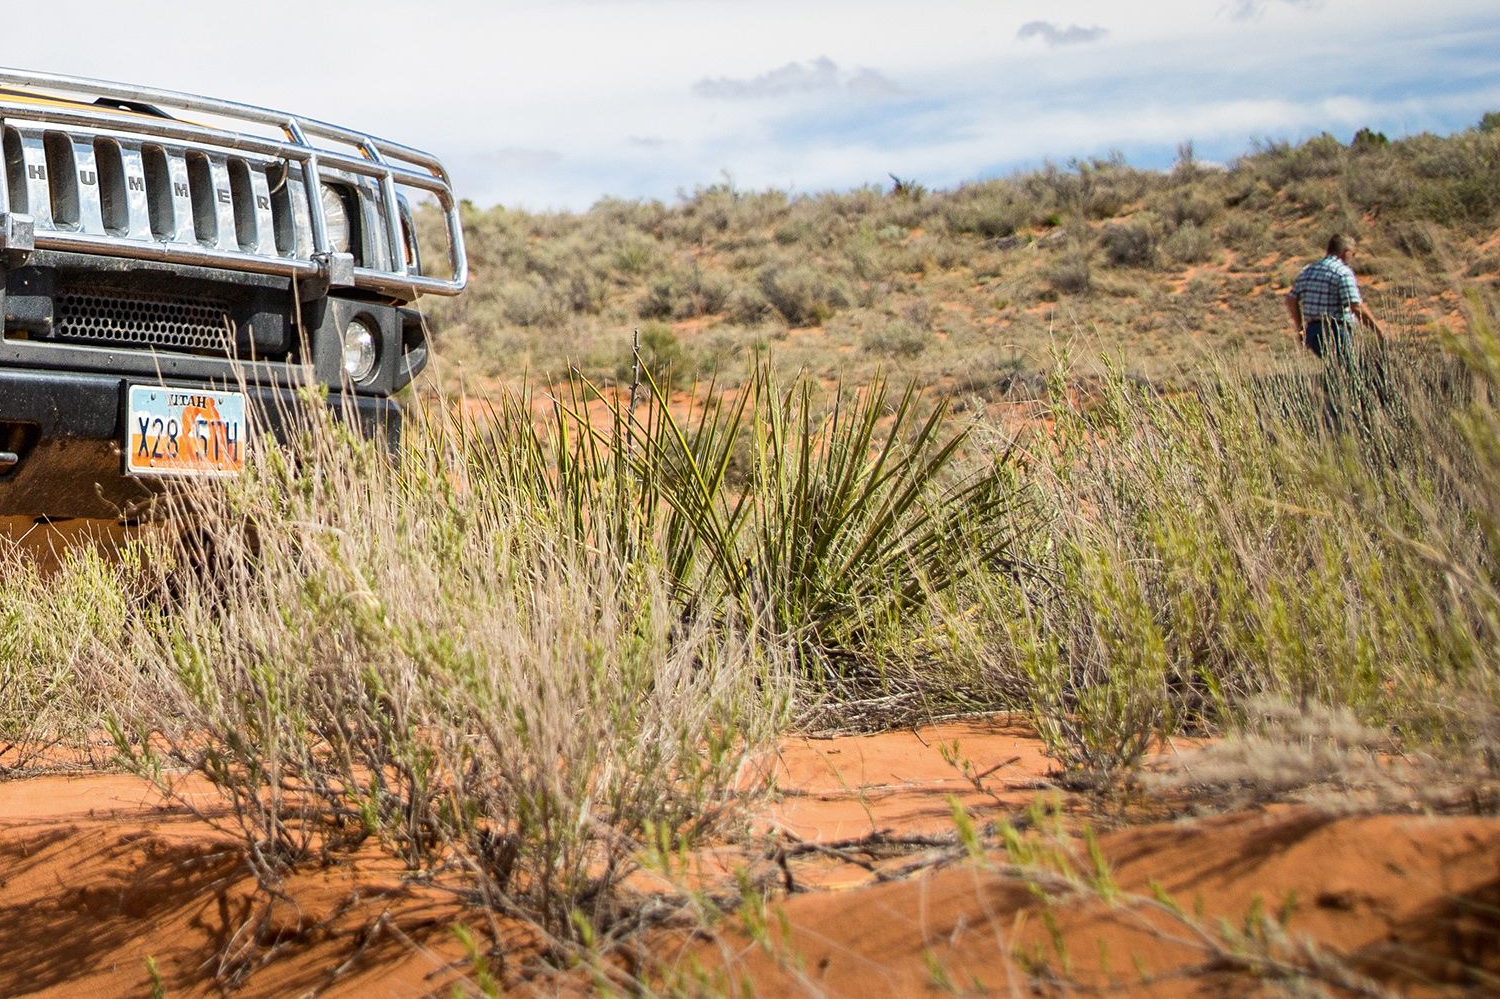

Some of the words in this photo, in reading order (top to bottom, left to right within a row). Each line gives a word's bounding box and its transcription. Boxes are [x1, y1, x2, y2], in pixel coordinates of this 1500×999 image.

[29, 164, 269, 210] HUMMER
[169, 394, 207, 409] UTAH
[138, 417, 178, 458] X28
